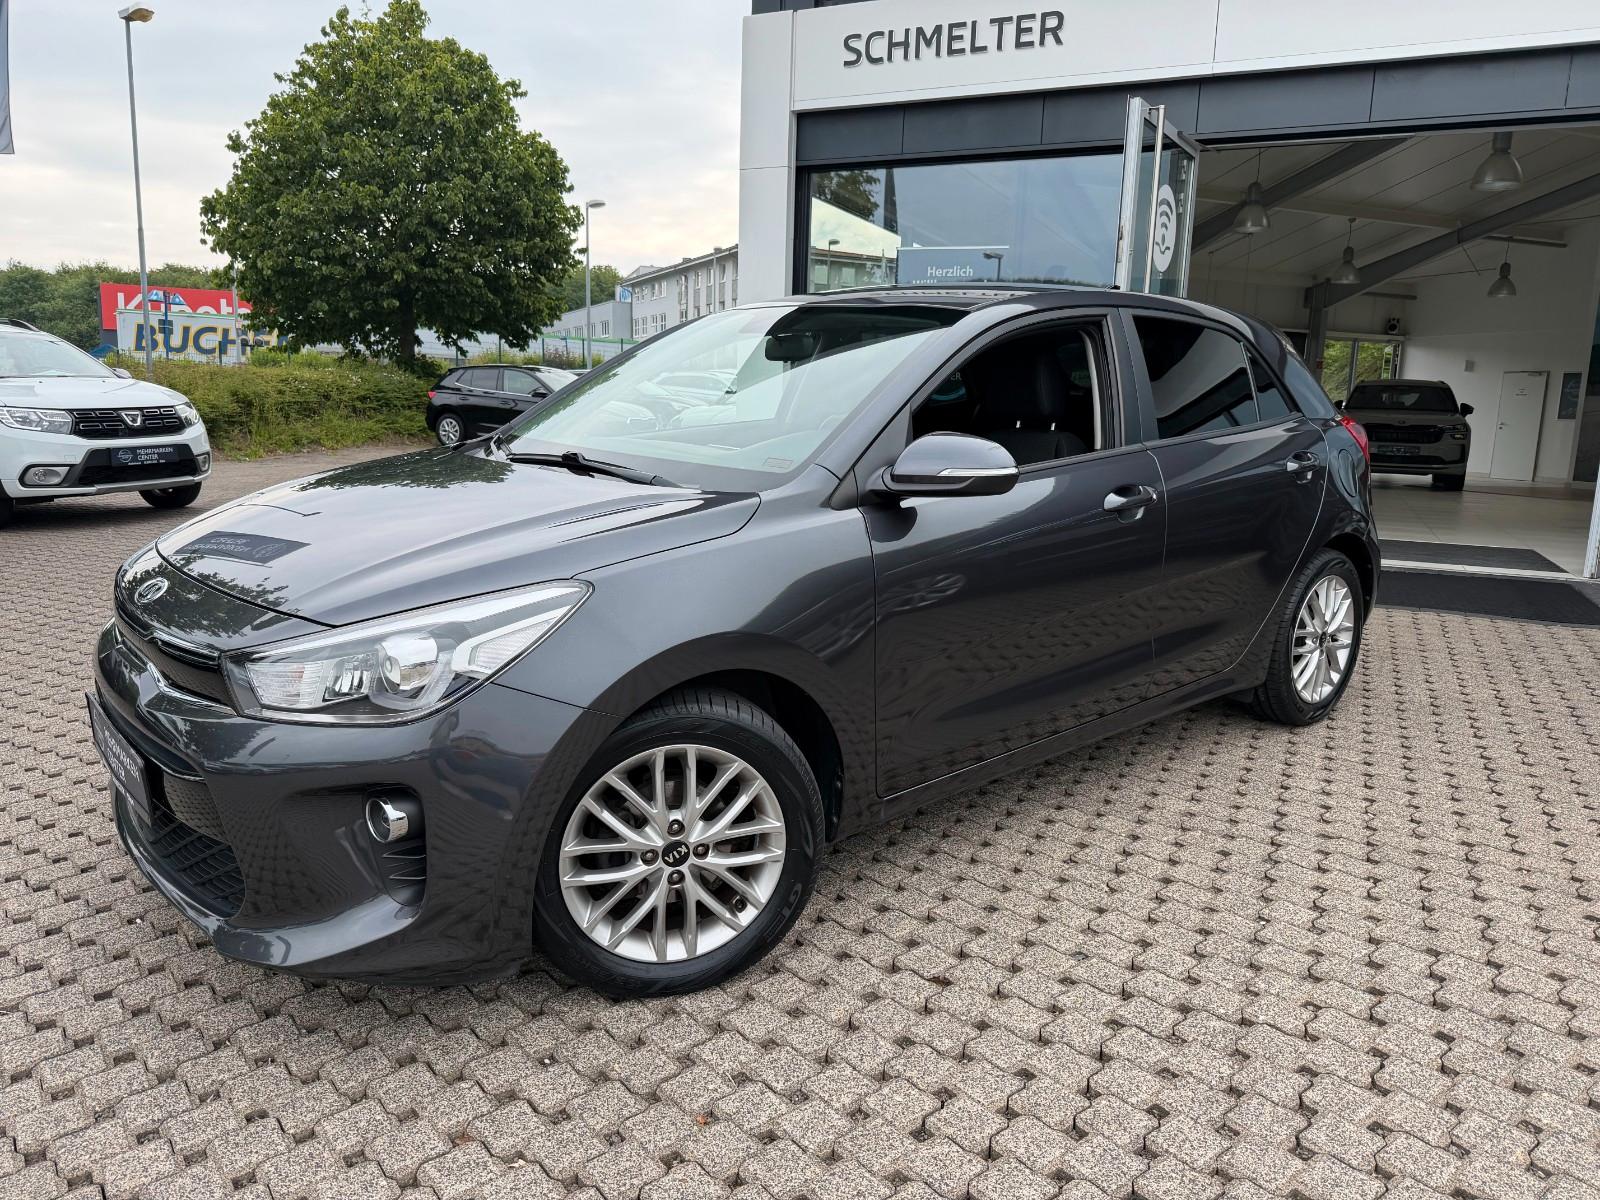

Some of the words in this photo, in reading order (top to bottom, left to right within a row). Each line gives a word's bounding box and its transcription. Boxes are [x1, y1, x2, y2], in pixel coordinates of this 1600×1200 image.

[843, 10, 1064, 68] SCHMELTER
[927, 265, 974, 277] Herzlich
[664, 844, 688, 863] KIA
